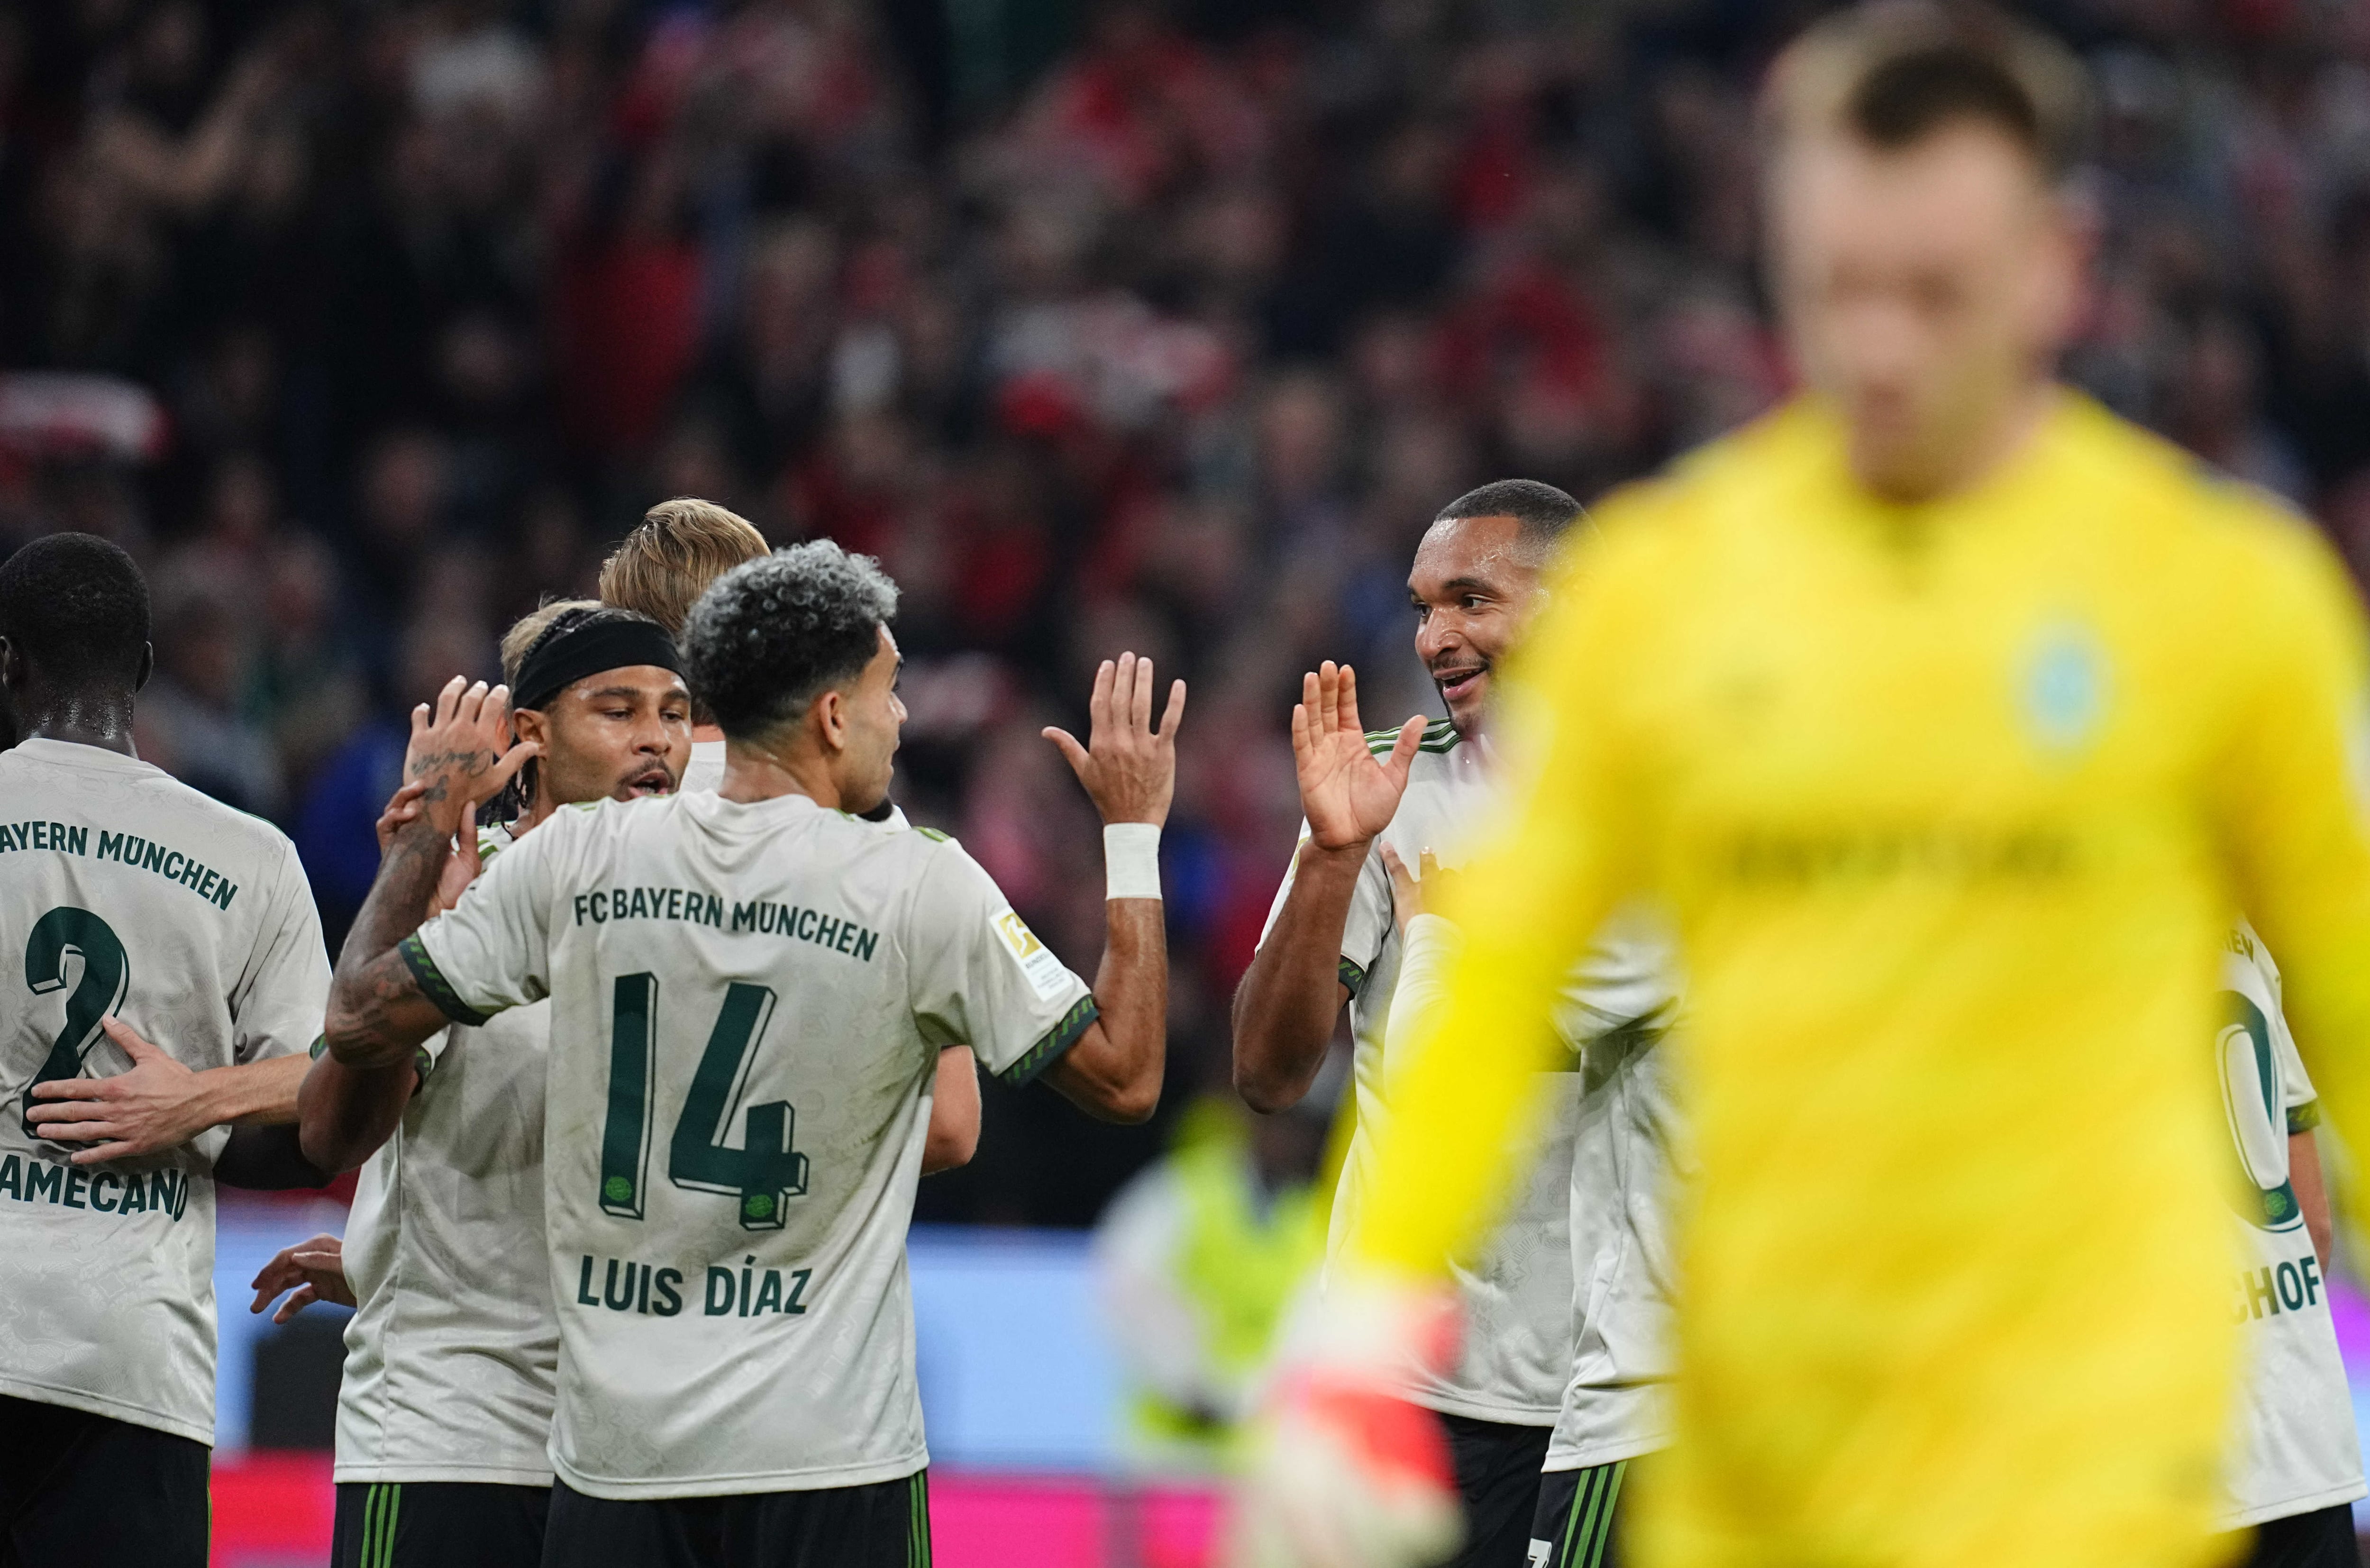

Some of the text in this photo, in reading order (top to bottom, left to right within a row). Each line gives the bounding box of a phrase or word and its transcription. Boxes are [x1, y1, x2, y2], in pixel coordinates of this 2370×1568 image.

[0, 821, 238, 911] AYERN MÜNCHEN
[732, 901, 879, 962] MÜNCHEN
[22, 906, 130, 1140] 2
[599, 971, 810, 1231] 14
[0, 1154, 189, 1222] AMECANO
[577, 1254, 812, 1318] LUIS DÍAZ
